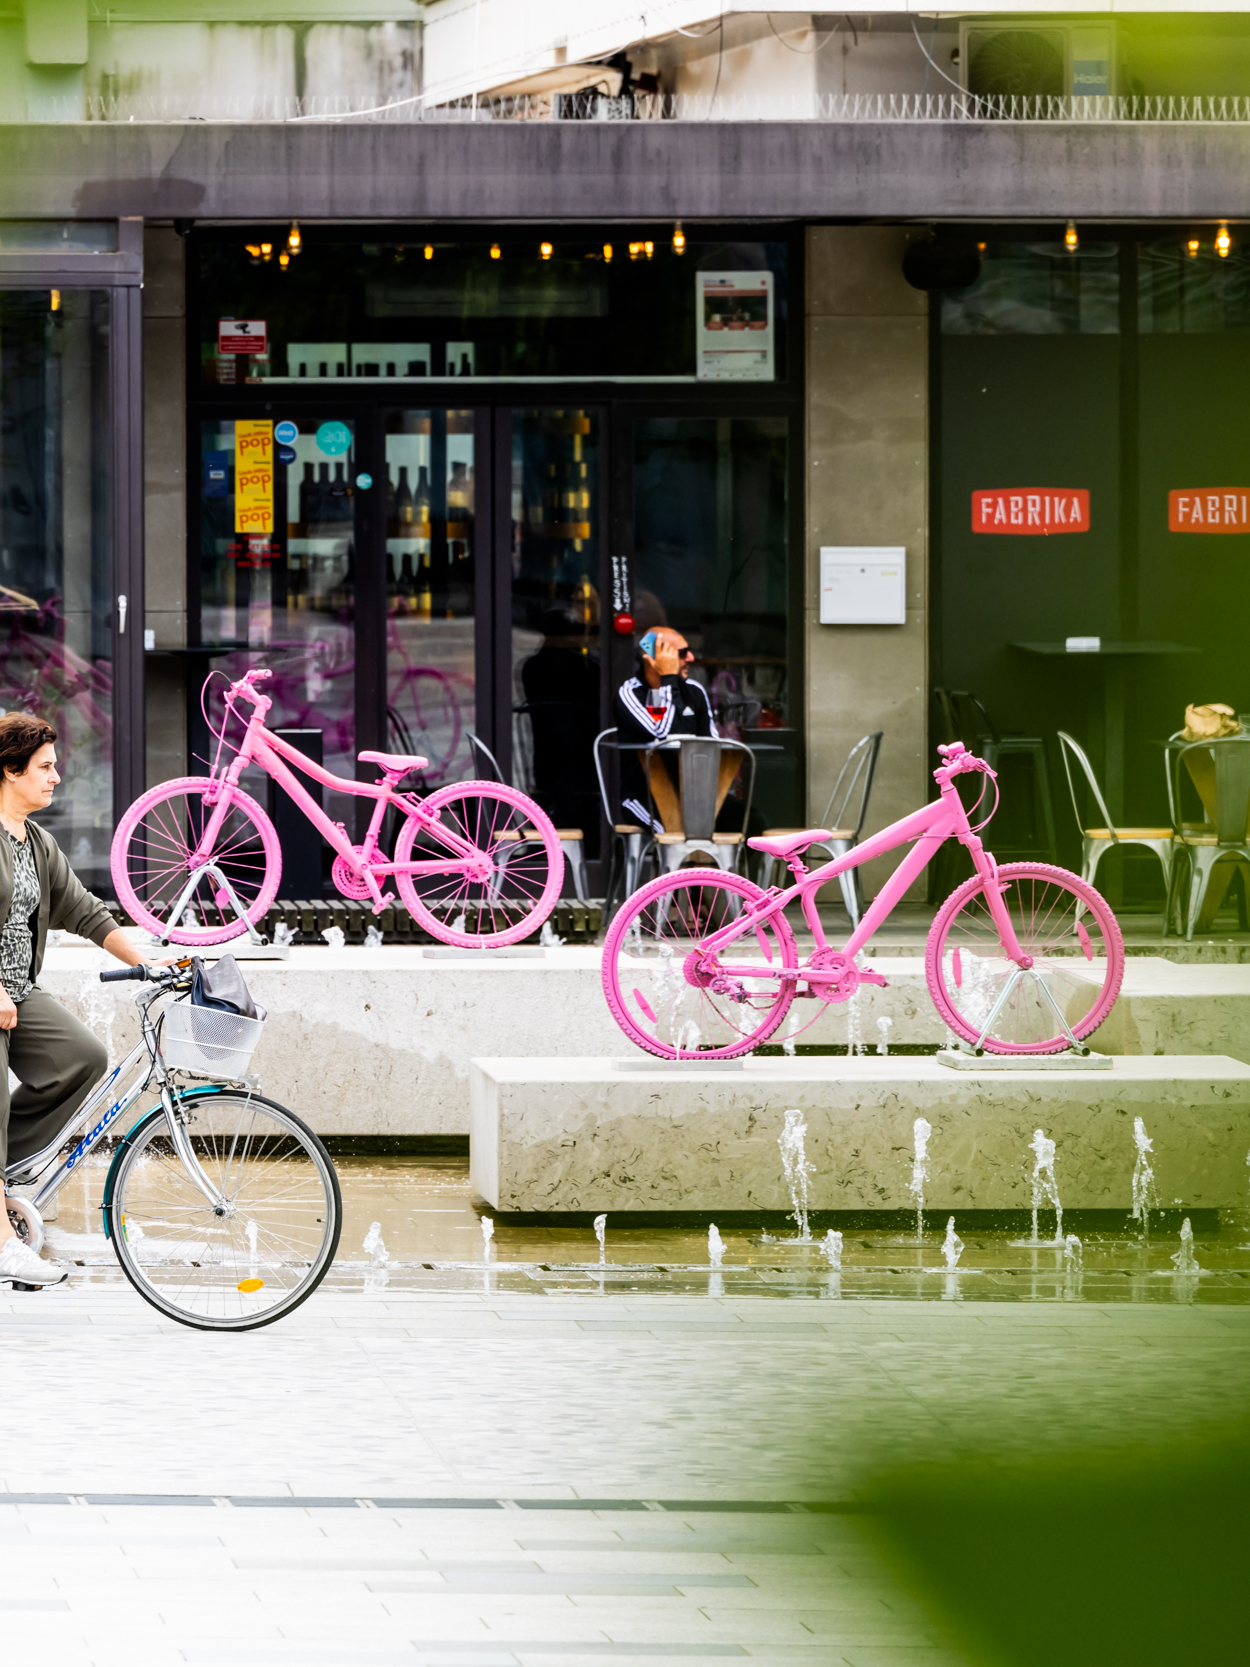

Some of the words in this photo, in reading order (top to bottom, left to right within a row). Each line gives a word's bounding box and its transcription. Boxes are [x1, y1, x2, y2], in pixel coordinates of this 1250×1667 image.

[238, 436, 272, 456] pop
[238, 473, 272, 494] pop
[981, 495, 1082, 526] FABRIKA
[238, 511, 272, 531] pop
